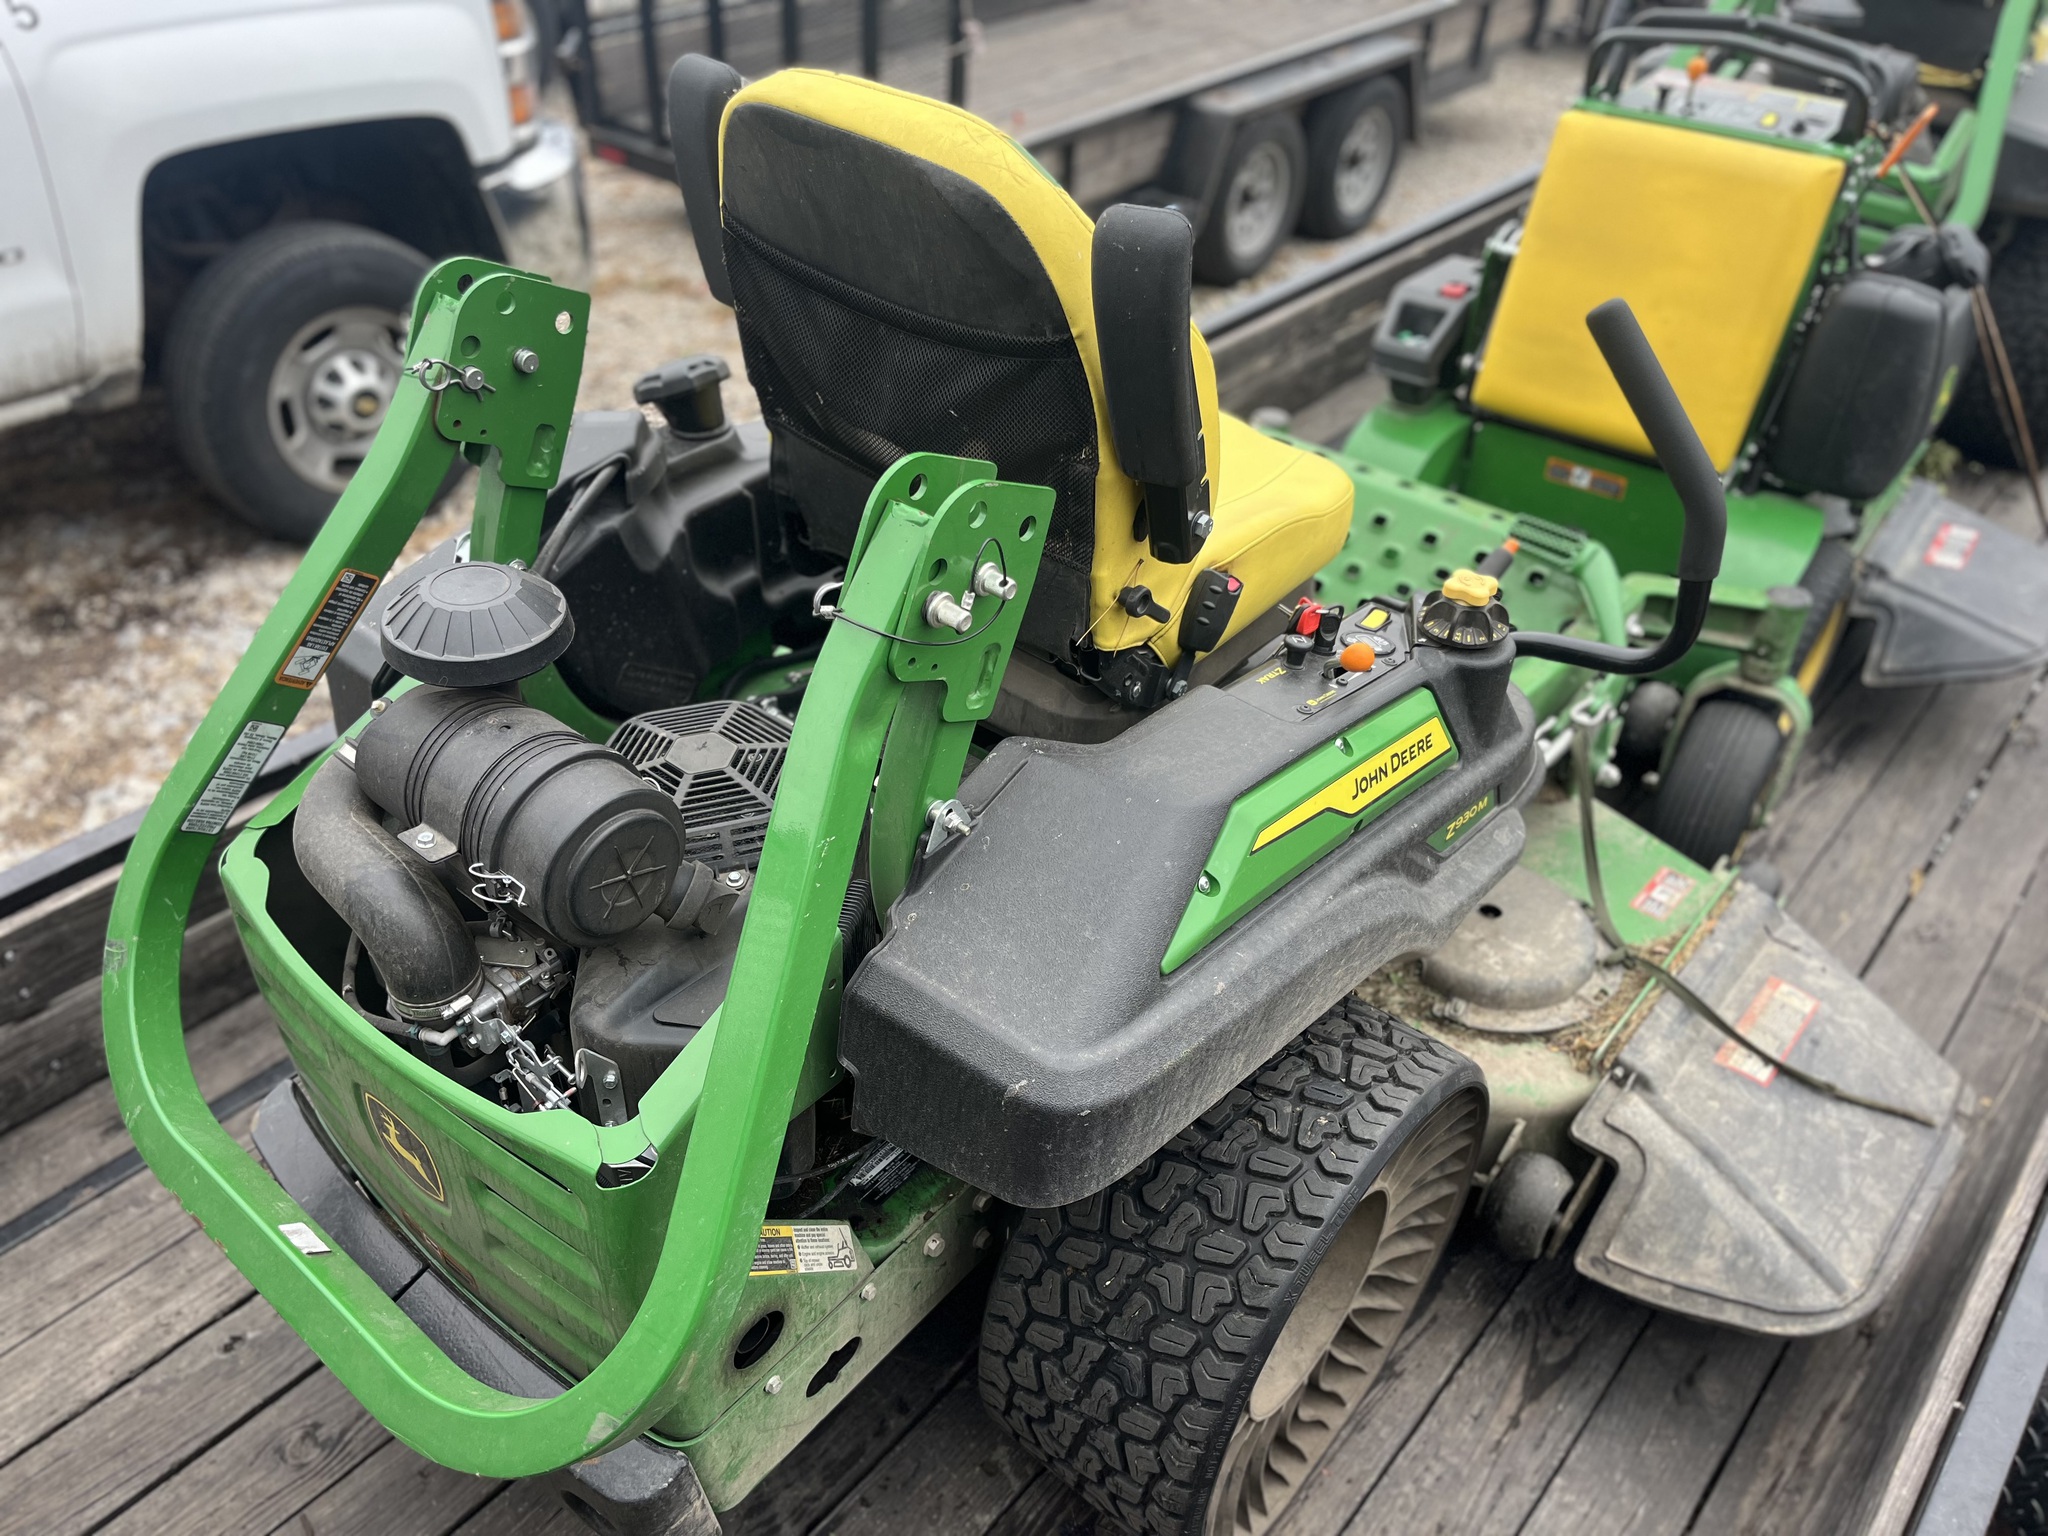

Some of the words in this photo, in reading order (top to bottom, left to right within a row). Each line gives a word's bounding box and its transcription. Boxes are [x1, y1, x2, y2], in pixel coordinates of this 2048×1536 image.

[1351, 762, 1389, 801] JOHN
[1390, 732, 1433, 774] DEERE
[1445, 796, 1488, 841] Z930M
[760, 1228, 781, 1237] AUTION
[1294, 1231, 1334, 1287] TWEEL
[1224, 1382, 1250, 1434] HIGHWAY
[1248, 1354, 1263, 1381] USE
